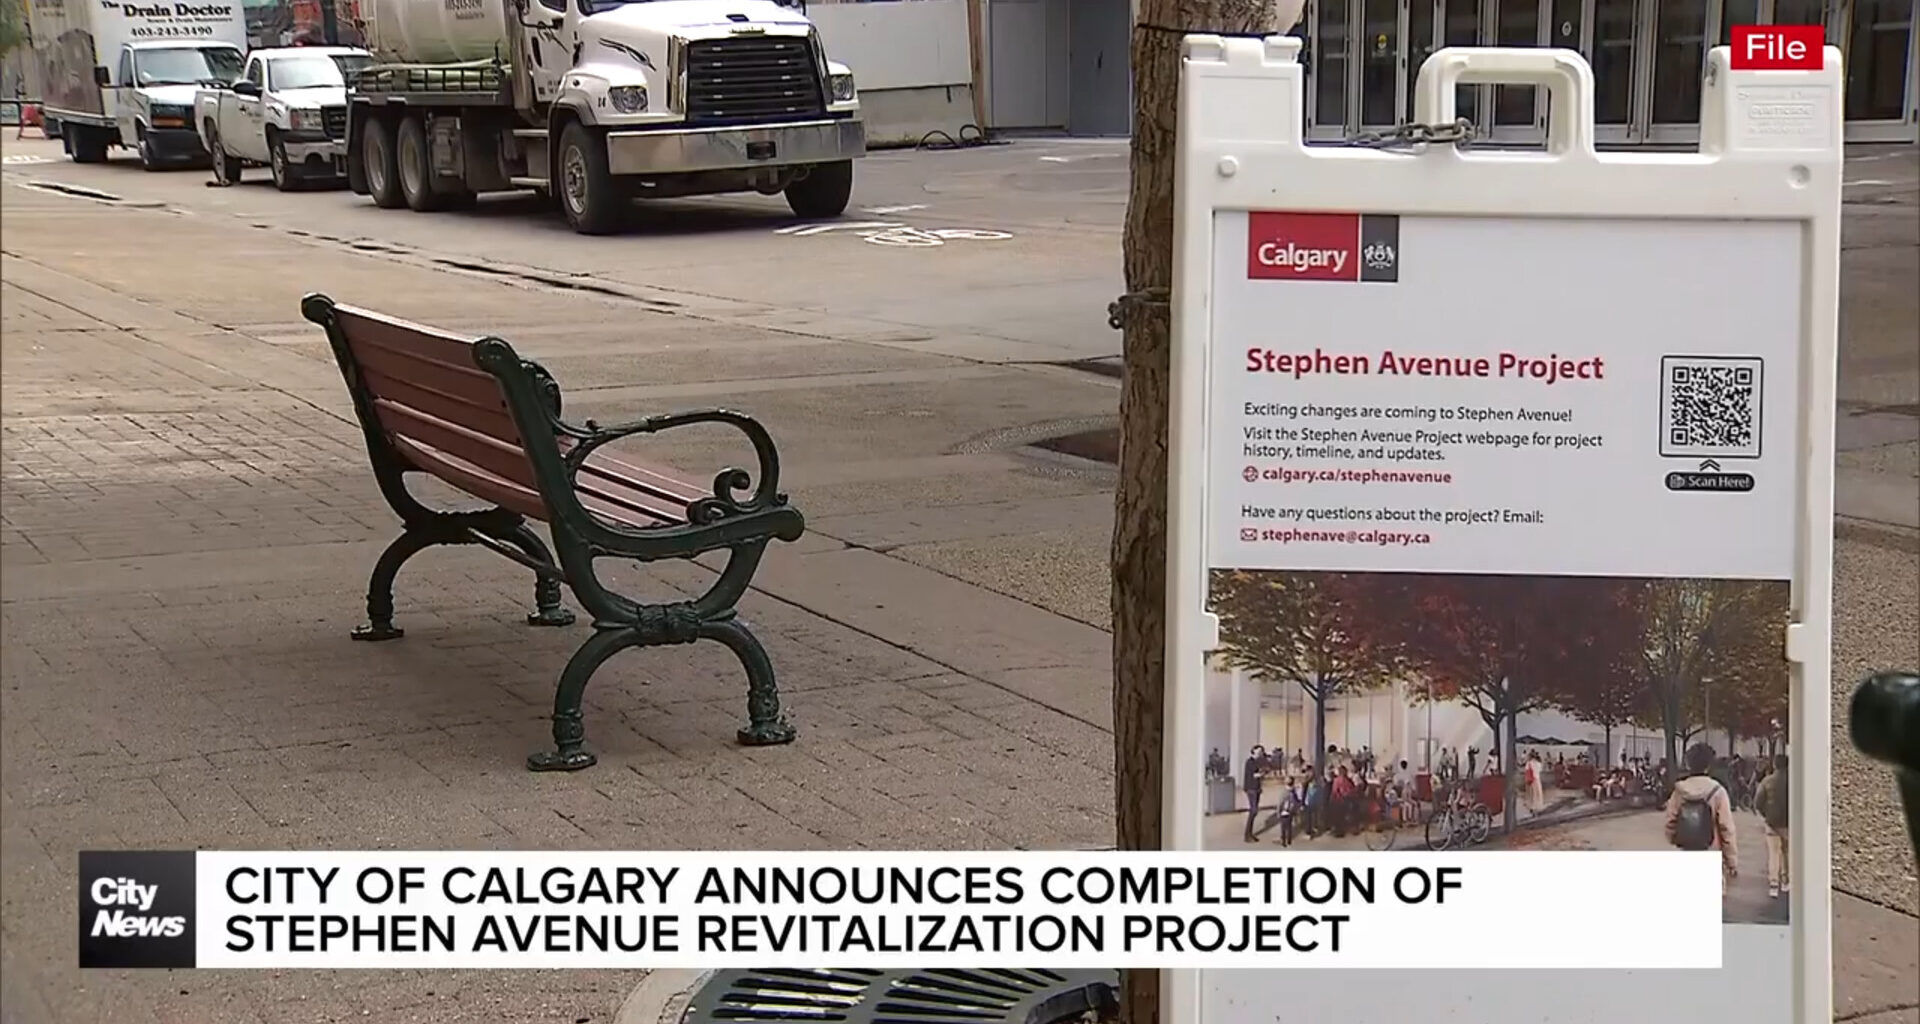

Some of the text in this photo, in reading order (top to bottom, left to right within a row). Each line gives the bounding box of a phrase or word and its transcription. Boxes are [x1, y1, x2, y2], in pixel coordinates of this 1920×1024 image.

[101, 0, 120, 9] The
[123, 3, 232, 17] Drain Doctor
[131, 26, 213, 37] 403-243-3490
[1258, 242, 1348, 273] Calgary
[1246, 348, 1605, 385] Stephen Avenue Project
[1244, 402, 1573, 423] Exciting changes are coming to Stephen Avenue!
[1243, 427, 1603, 449] Visit the Stephen Avenue Project webpage for project
[1243, 443, 1446, 463] history, timeline, and updates.
[1262, 467, 1452, 485] calgary.ca/stephenavenue
[1688, 475, 1750, 488] Scan Here!
[1241, 504, 1544, 525] Have any questions about the project? Email:
[1262, 528, 1431, 546] stephenave@calgary.ca
